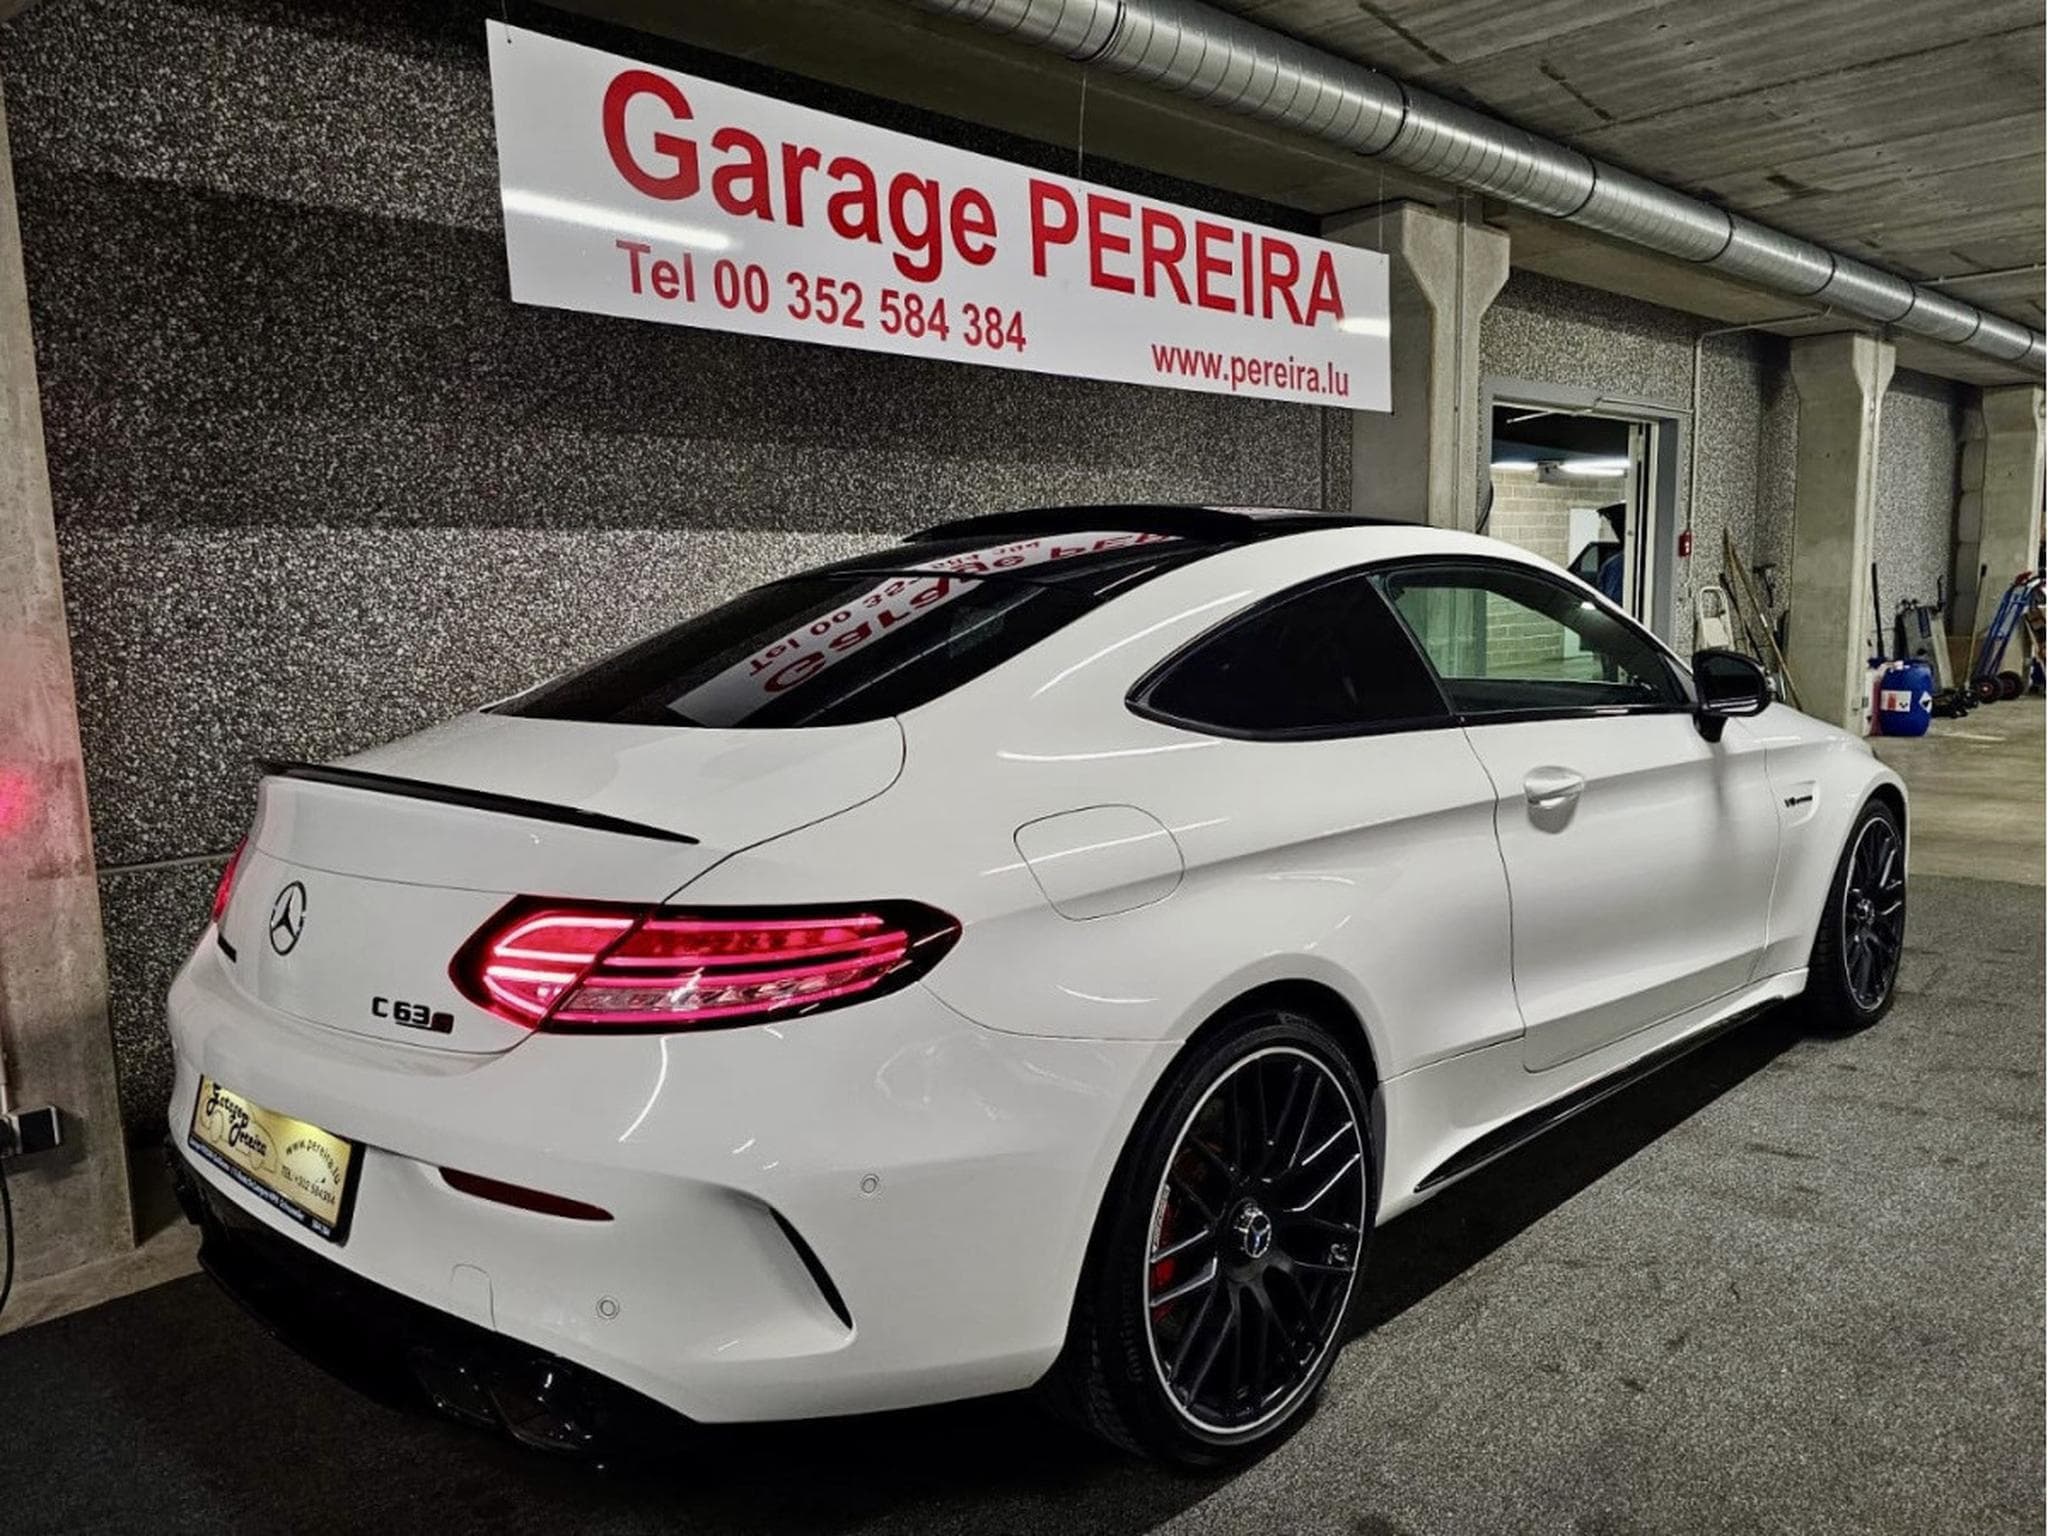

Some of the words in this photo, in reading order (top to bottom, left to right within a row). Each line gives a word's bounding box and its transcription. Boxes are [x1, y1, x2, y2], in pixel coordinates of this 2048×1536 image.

[602, 69, 998, 284] Garage
[1028, 178, 1345, 328] PEREIRA
[615, 239, 697, 303] Tel
[713, 259, 770, 314] 00
[786, 271, 865, 329] 352
[879, 288, 950, 341] 584
[962, 303, 1027, 353] 384
[1151, 343, 1349, 397] www.pereira.lu
[371, 996, 389, 1018] C
[393, 1001, 431, 1026] 63
